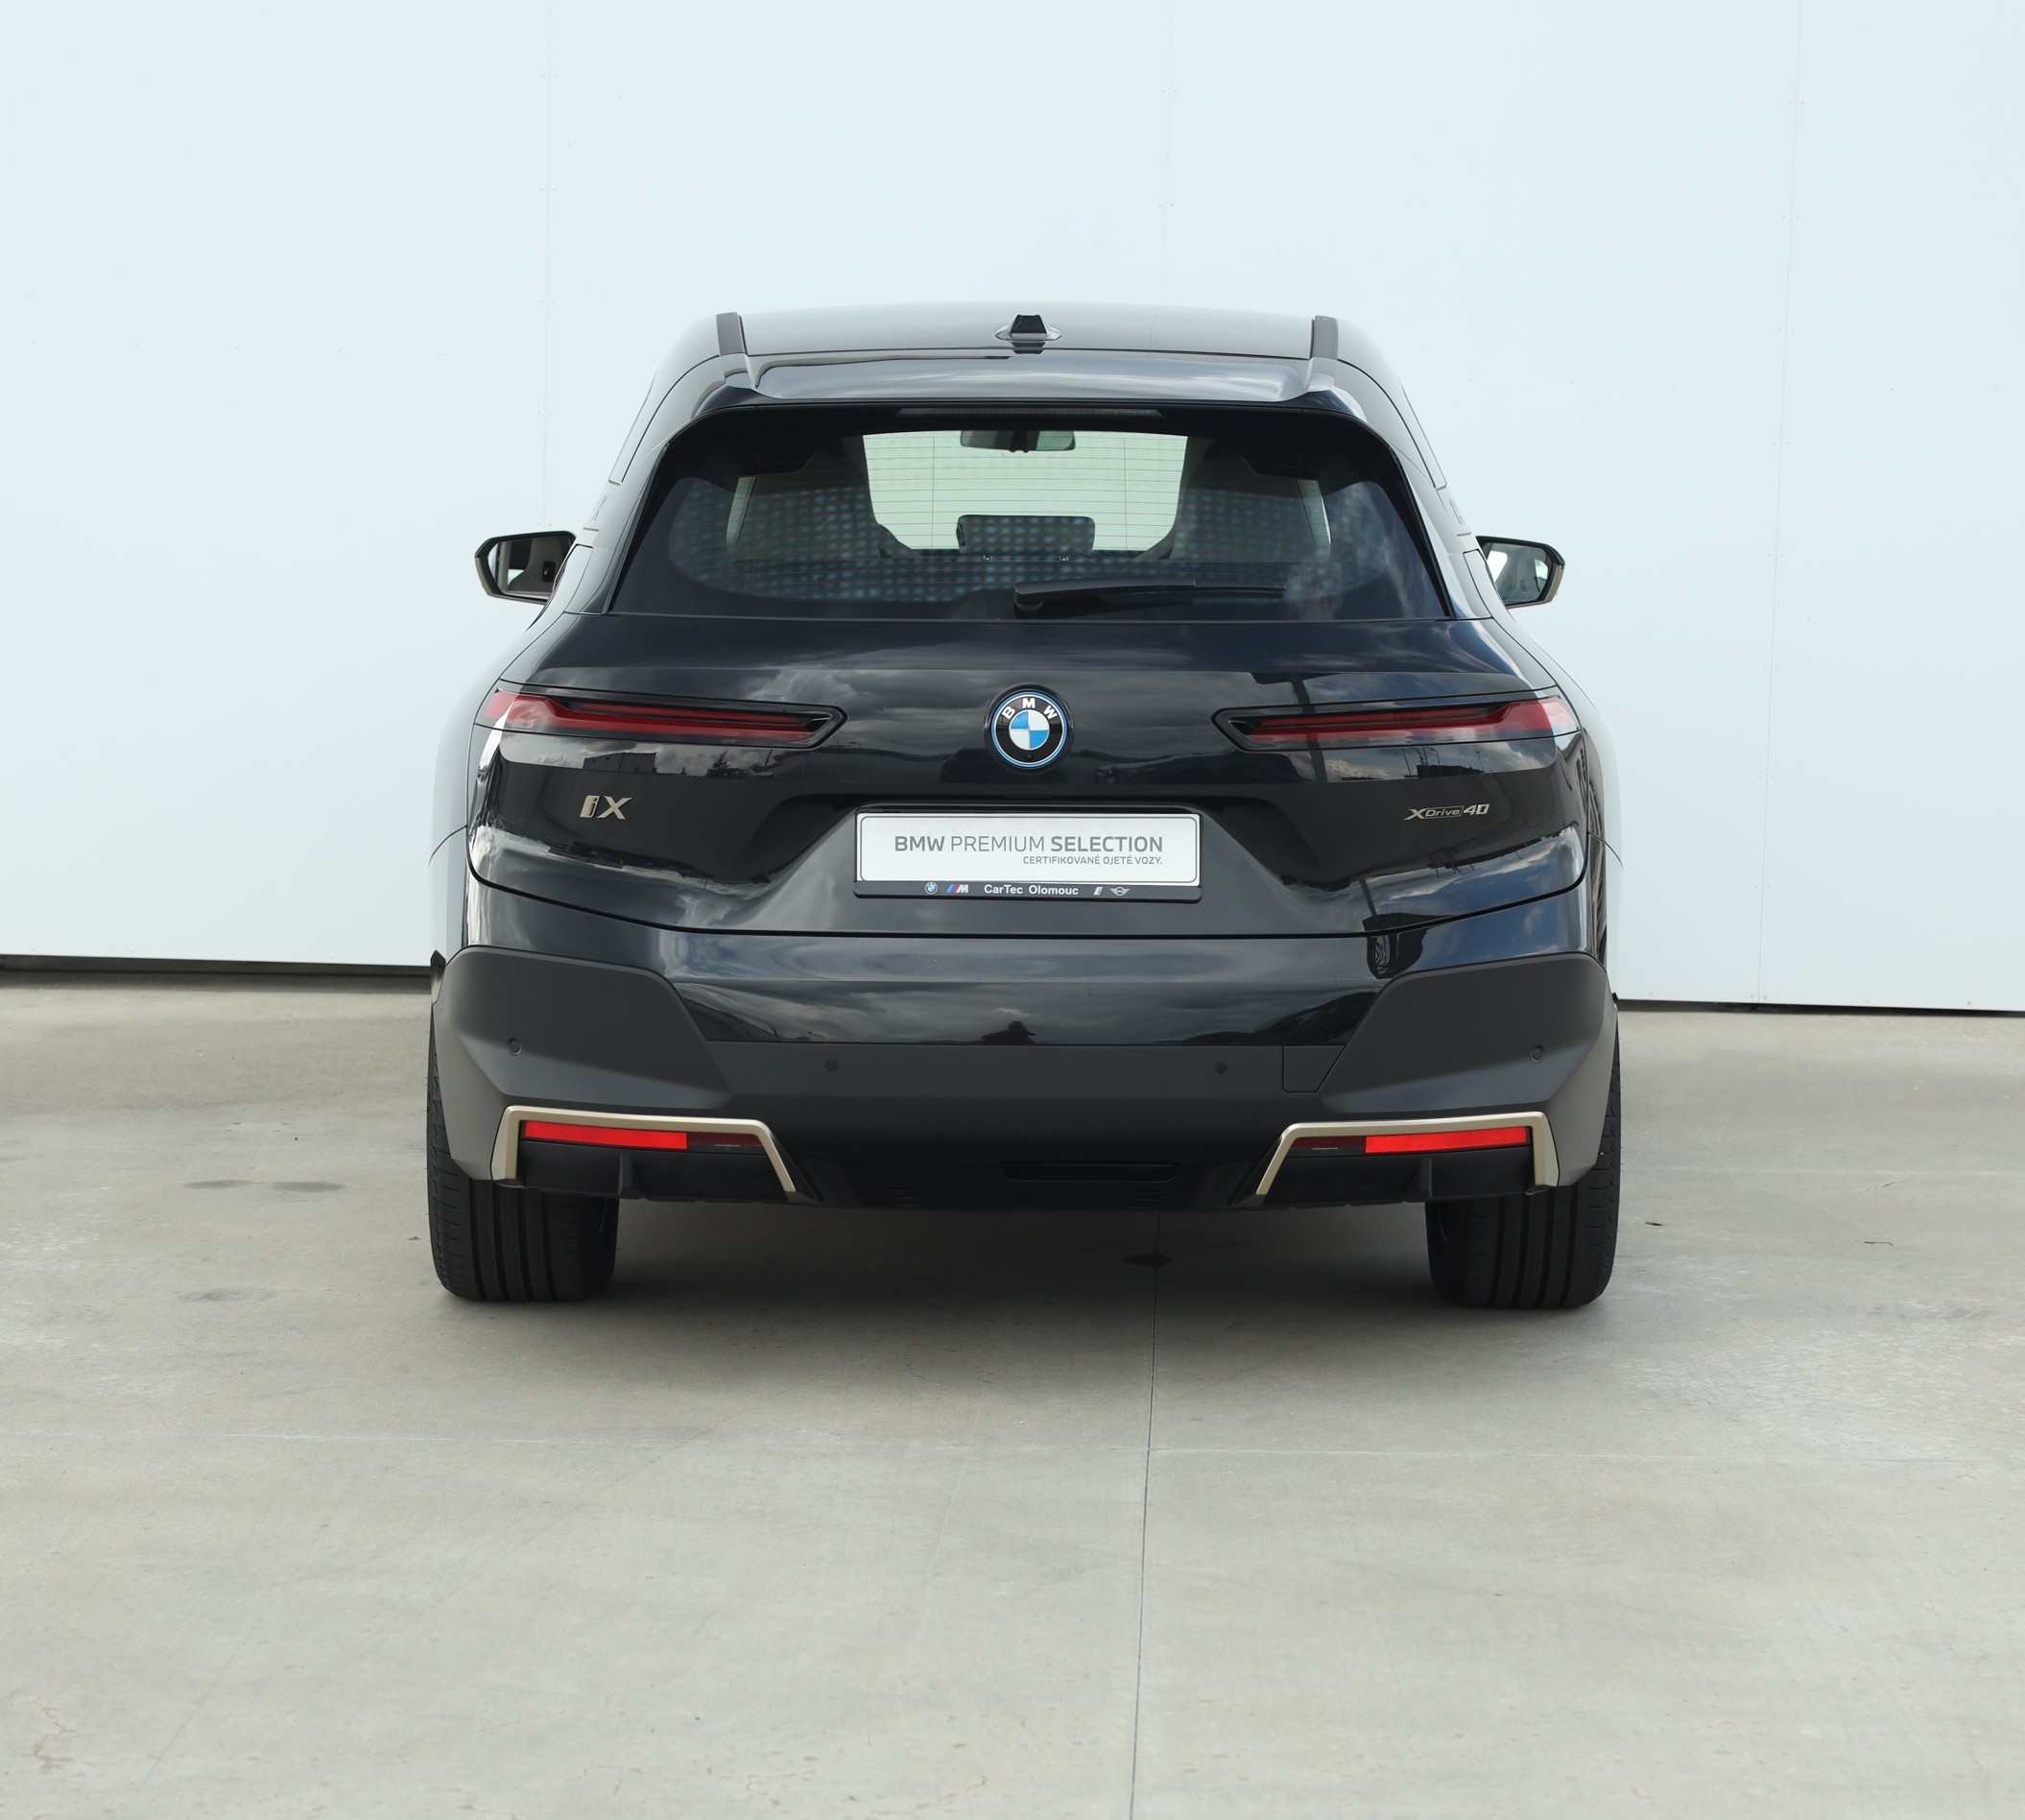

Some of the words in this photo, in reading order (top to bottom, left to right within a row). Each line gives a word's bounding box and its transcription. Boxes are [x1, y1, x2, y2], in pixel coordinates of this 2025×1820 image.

[1001, 697, 1058, 720] BMW
[894, 835, 945, 851] BMW
[951, 835, 1044, 852] PREMIUM
[1051, 835, 1163, 852] SELECTION
[1022, 855, 1101, 865] CERTIFIKOVANÉ
[1103, 854, 1132, 866] OJETÉ
[1134, 856, 1163, 865] VOZY.
[984, 884, 1023, 895] CarTec
[1028, 884, 1080, 896] Olomouc
